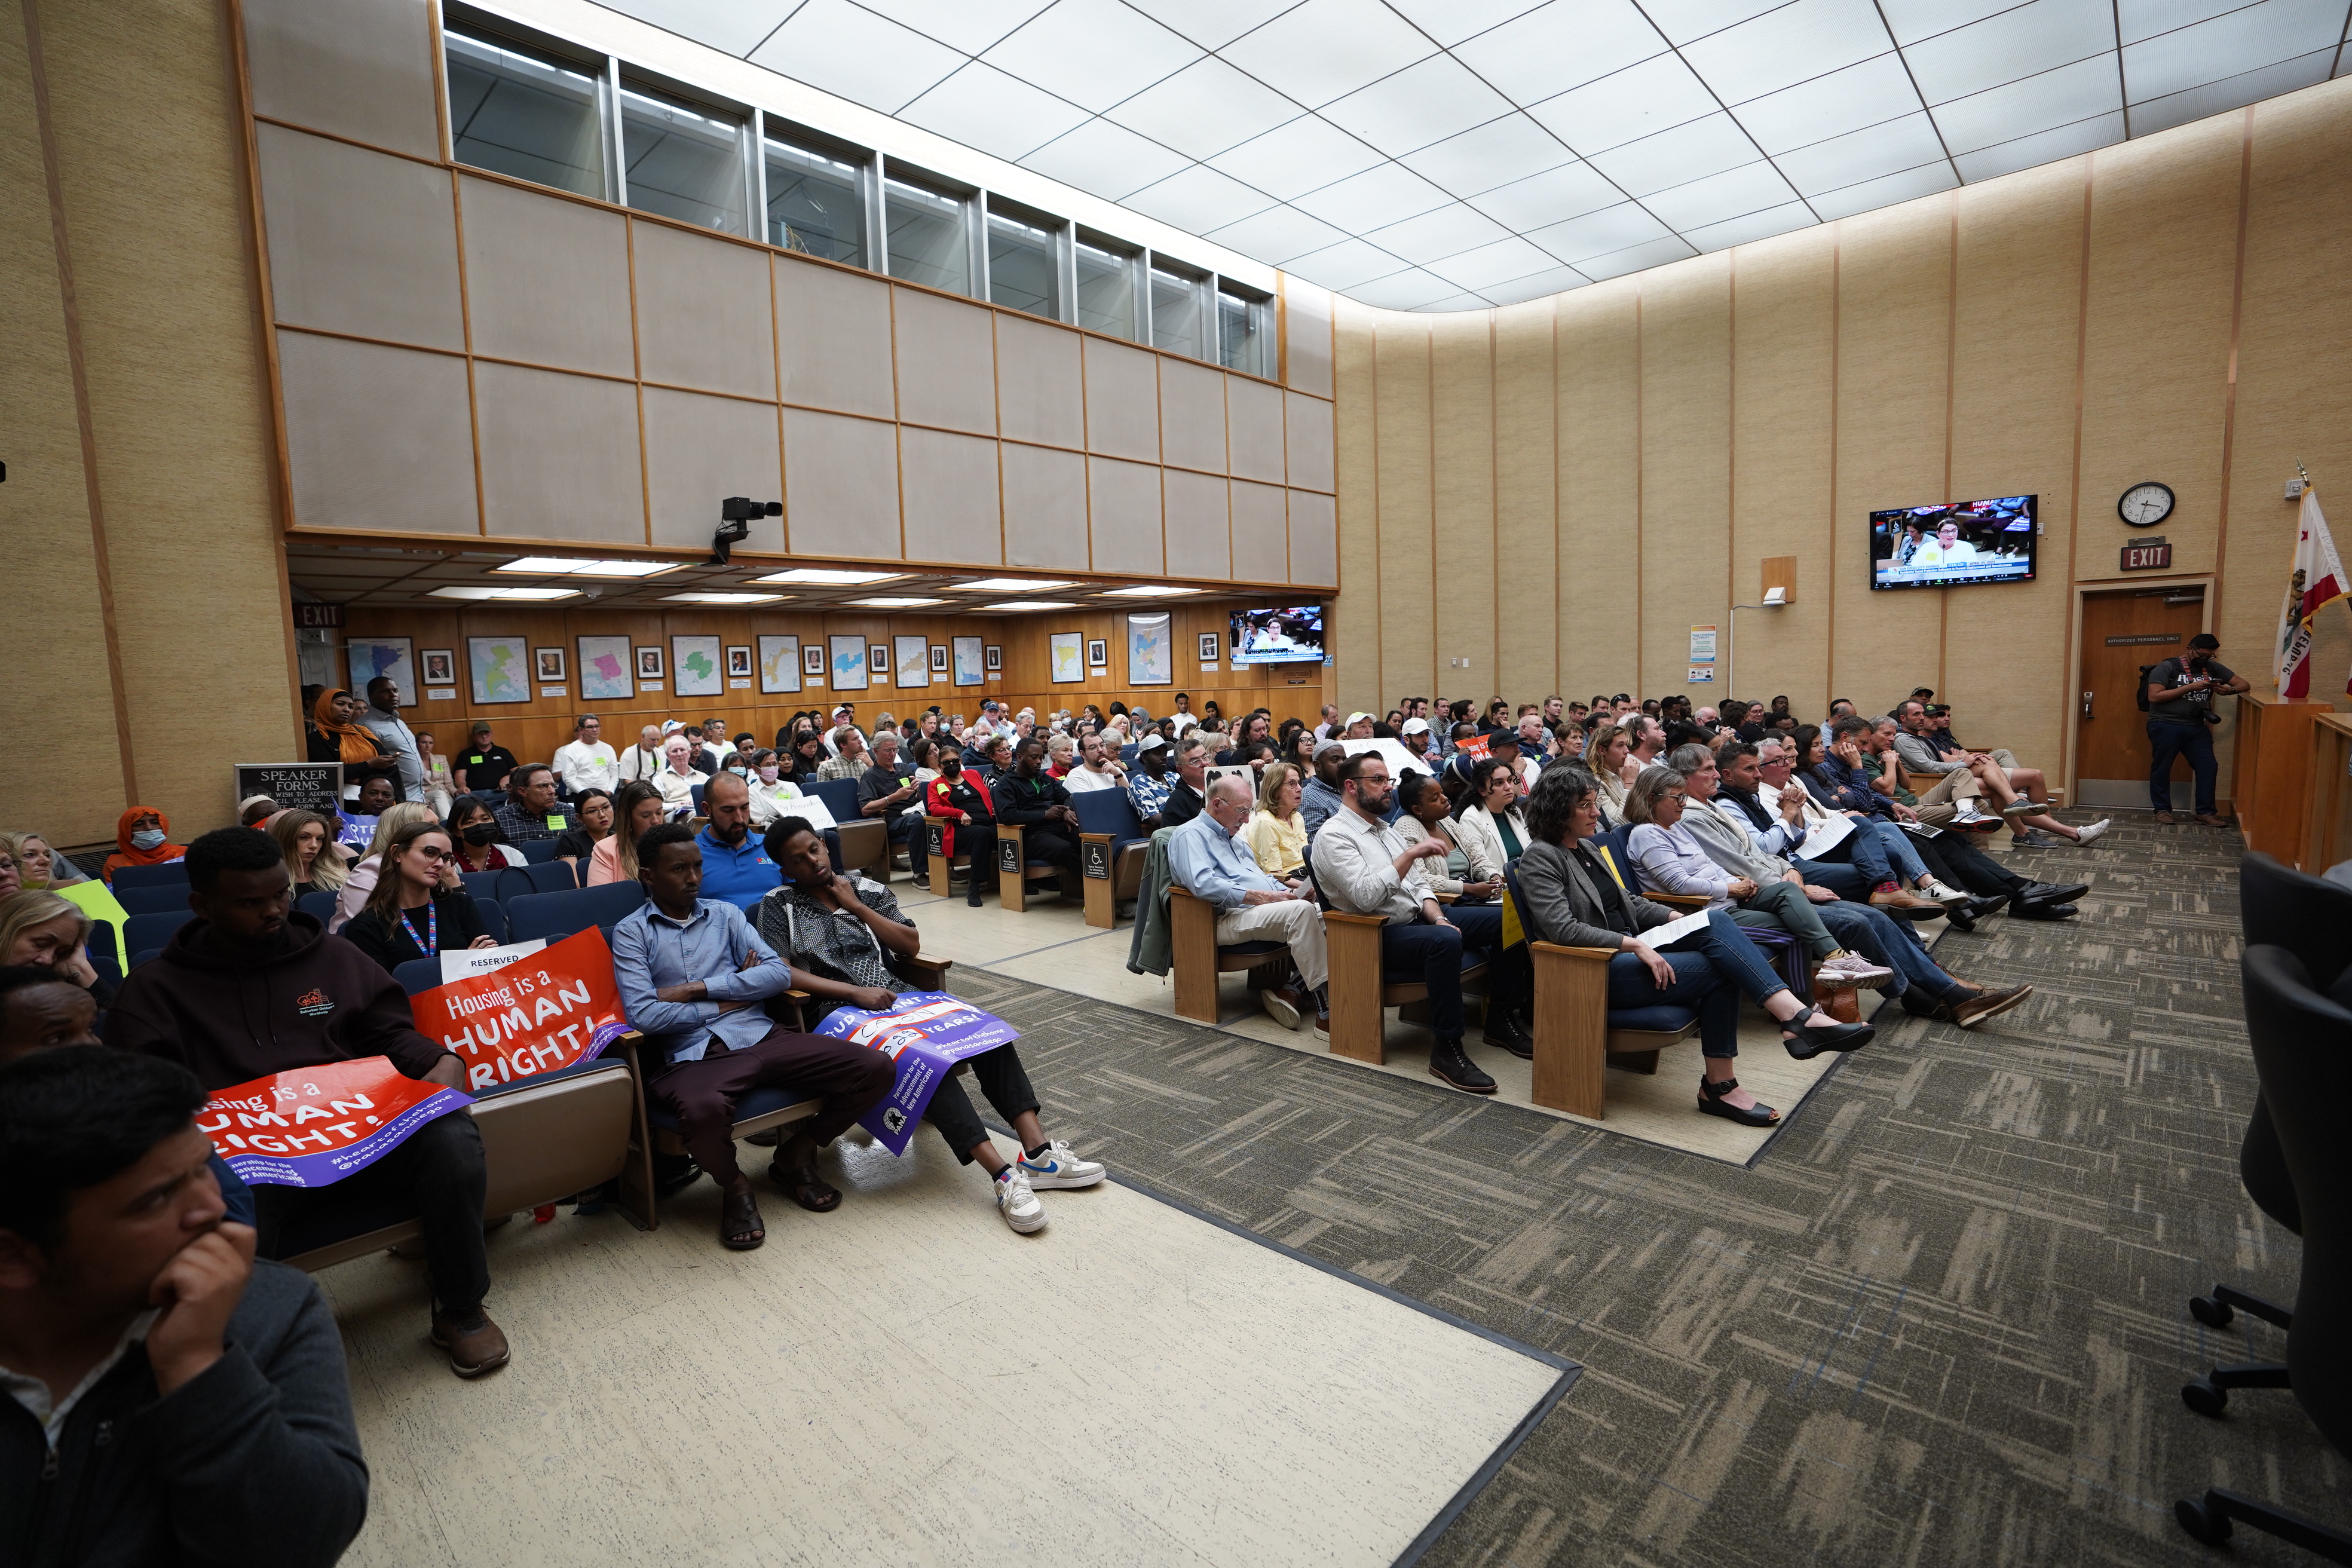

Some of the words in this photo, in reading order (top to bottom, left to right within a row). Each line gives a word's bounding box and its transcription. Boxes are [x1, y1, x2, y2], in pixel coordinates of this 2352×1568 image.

[2130, 547, 2163, 567] EXIT
[303, 606, 337, 626] EXIT
[261, 770, 327, 781] SPEAKER
[276, 780, 320, 791] FORMS
[471, 955, 519, 967] RESERVED
[445, 986, 510, 1020] Housing
[513, 977, 535, 996] is
[537, 970, 552, 985] a
[443, 979, 591, 1055] HUMAN
[922, 1013, 980, 1034] YEARS!
[935, 1027, 1005, 1051] #heartofthehome
[942, 1037, 1002, 1056] @panasandiego
[893, 1072, 911, 1099] Partnership
[912, 1057, 921, 1067] the
[899, 1068, 923, 1105] Advancement
[920, 1062, 927, 1070] of
[270, 1086, 298, 1102] is
[303, 1083, 321, 1096] a
[906, 1097, 917, 1111] New
[913, 1068, 934, 1099] Americans
[196, 1093, 375, 1134] UMAN
[330, 1094, 454, 1165] #heartofthehome
[893, 1114, 908, 1135] PANA
[338, 1106, 443, 1170] @panasandiego
[229, 1159, 265, 1169] nership
